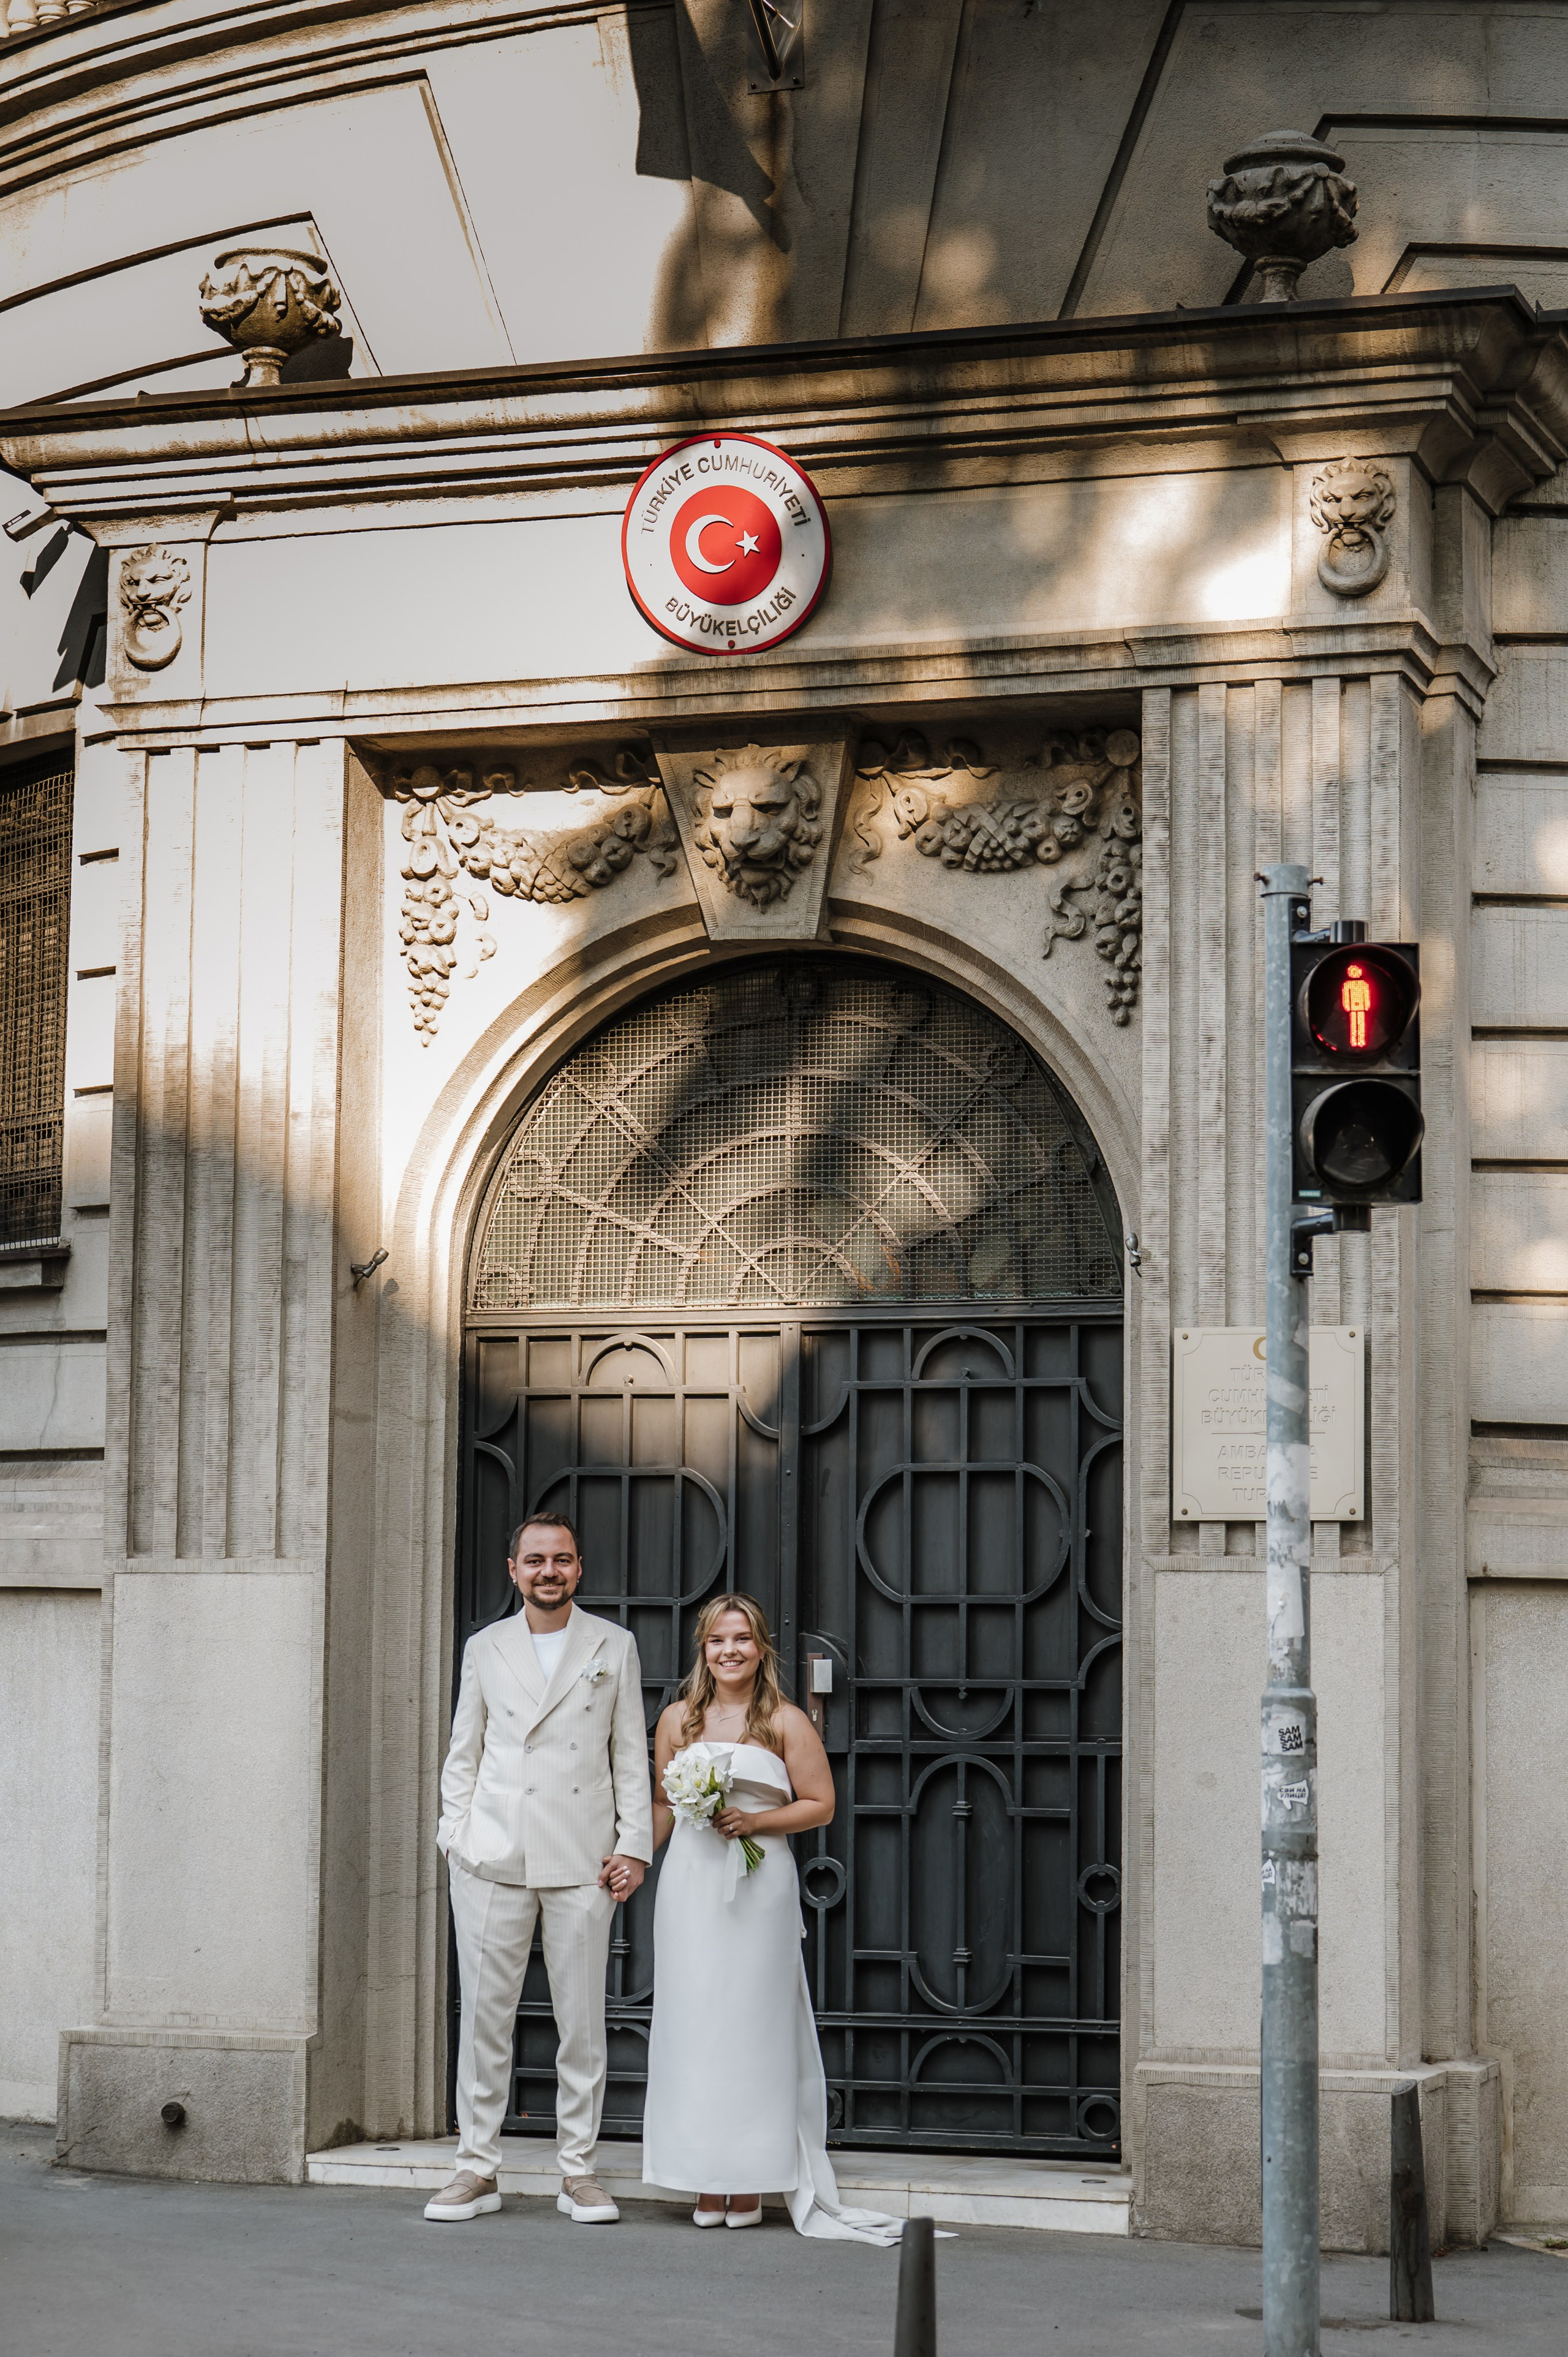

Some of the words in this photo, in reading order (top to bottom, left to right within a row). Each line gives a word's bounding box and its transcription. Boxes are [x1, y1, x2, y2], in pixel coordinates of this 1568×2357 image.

[641, 462, 695, 534] TÜRKİYE
[697, 454, 811, 526] CUMHURİYETİ
[665, 586, 797, 636] BÜYÜKELÇİLİĞİ
[1278, 1725, 1300, 1737] SAM
[1280, 1732, 1302, 1744] SAM
[1281, 1740, 1303, 1752] SAM
